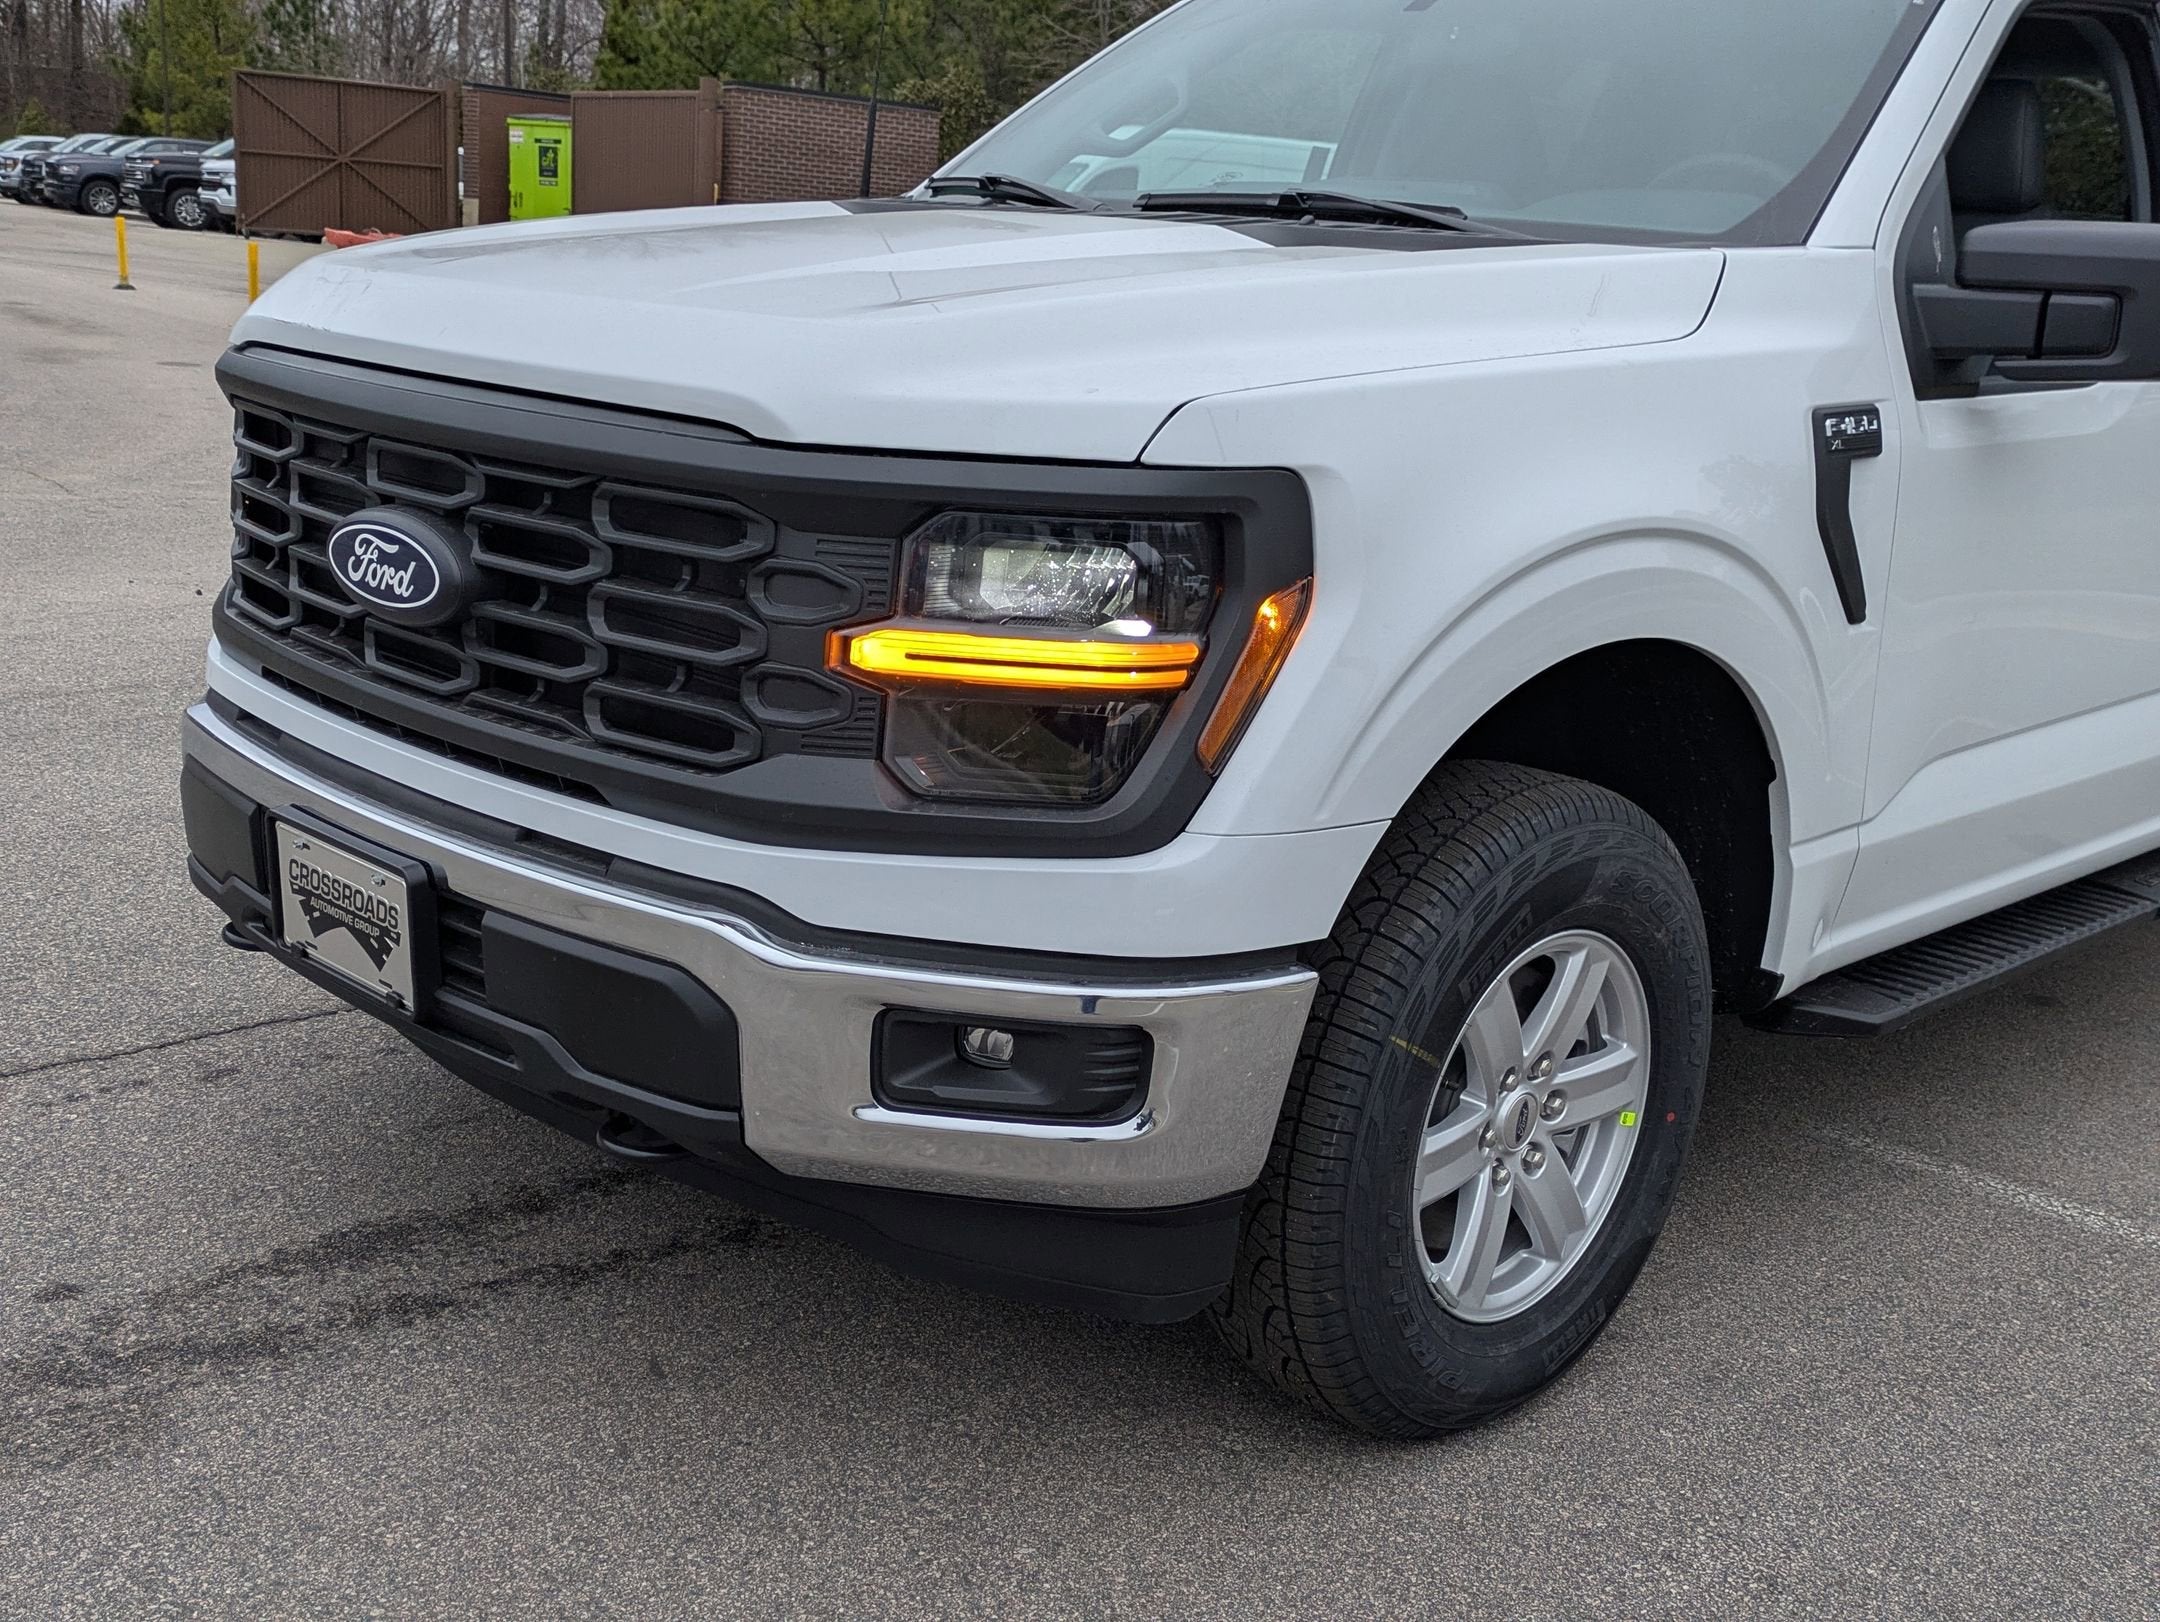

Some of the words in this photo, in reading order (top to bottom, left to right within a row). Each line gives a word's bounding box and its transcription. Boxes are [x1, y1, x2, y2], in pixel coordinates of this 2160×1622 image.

[347, 533, 416, 598] Ford
[289, 858, 400, 930] CROSSROADS
[310, 896, 354, 926] AUTOMOTIVE
[354, 918, 380, 937] GROUP
